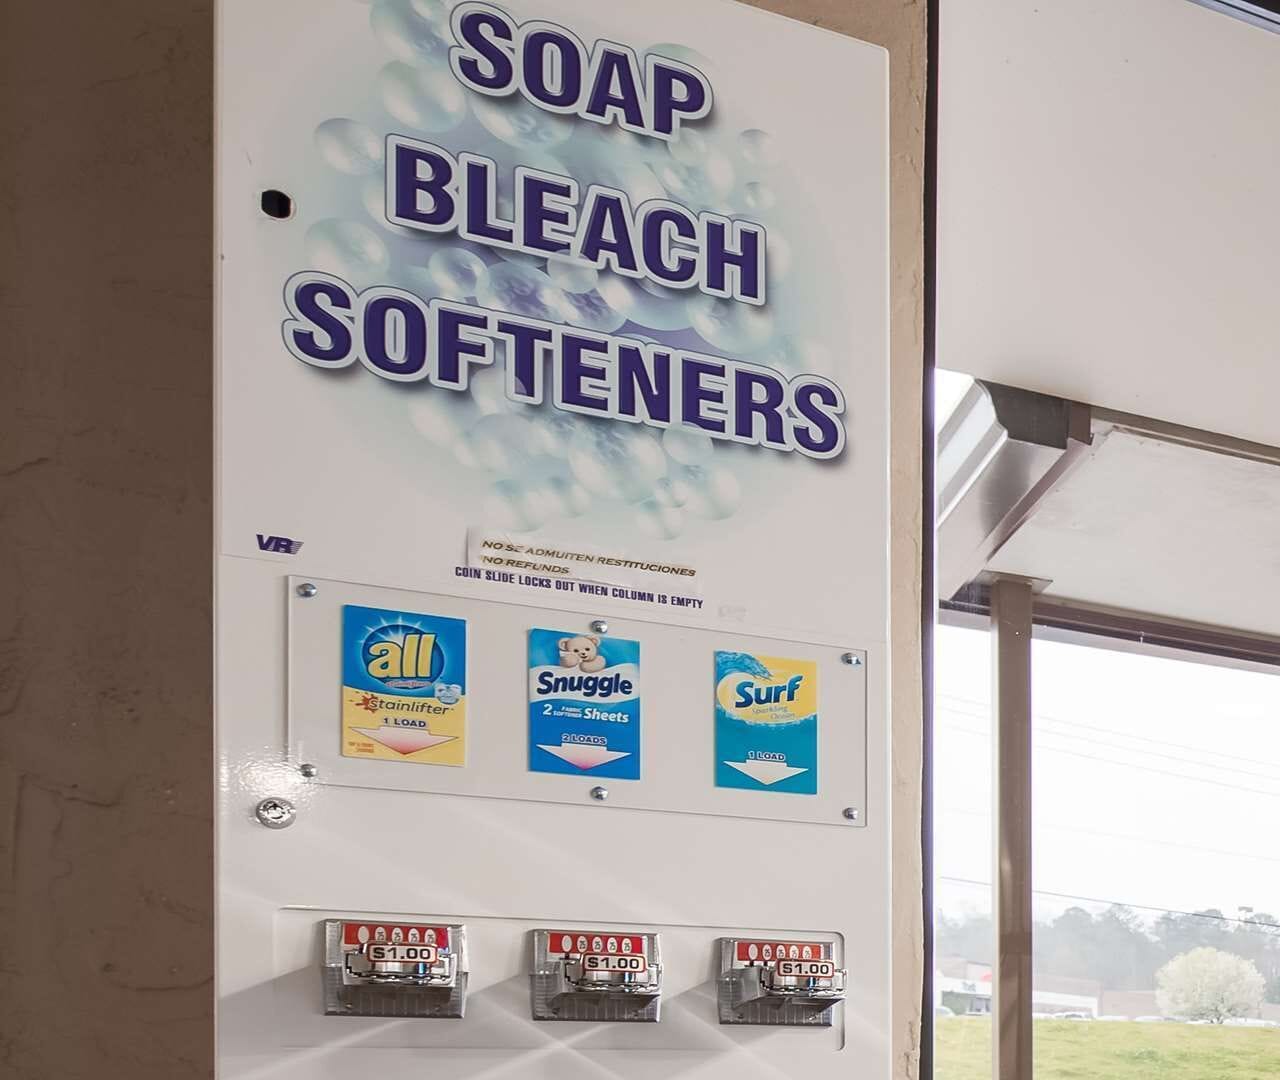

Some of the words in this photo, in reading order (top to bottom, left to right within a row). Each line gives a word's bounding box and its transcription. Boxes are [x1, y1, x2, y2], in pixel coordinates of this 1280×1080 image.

[454, 5, 709, 139] SOAP
[390, 139, 762, 304] BLEACH
[288, 276, 844, 458] SOFTENERS
[482, 540, 504, 550] NO
[597, 556, 697, 577] RESTITUCIONES
[482, 555, 504, 565] NO
[505, 558, 571, 575] REFUNDS
[455, 566, 481, 579] COIN
[485, 570, 515, 584] SLIDE
[518, 575, 552, 589] LOCKS
[555, 580, 575, 592] OUT
[578, 583, 609, 597] WHEN
[612, 587, 655, 603] COLUMN
[657, 593, 668, 604] IS
[670, 596, 704, 609] EMPTY
[367, 632, 437, 679] all
[536, 671, 633, 698] Snuggle
[734, 674, 804, 709] Surf
[368, 697, 449, 716] stainlifter
[543, 703, 553, 716] 2
[583, 707, 630, 723] Sheets
[394, 718, 427, 728] LOAD
[561, 733, 569, 742] 2
[572, 734, 607, 746] LOADS
[757, 751, 786, 761] LOAD
[372, 946, 432, 960] $1.00
[587, 956, 640, 970] $1.00
[782, 963, 830, 975] $1.00
